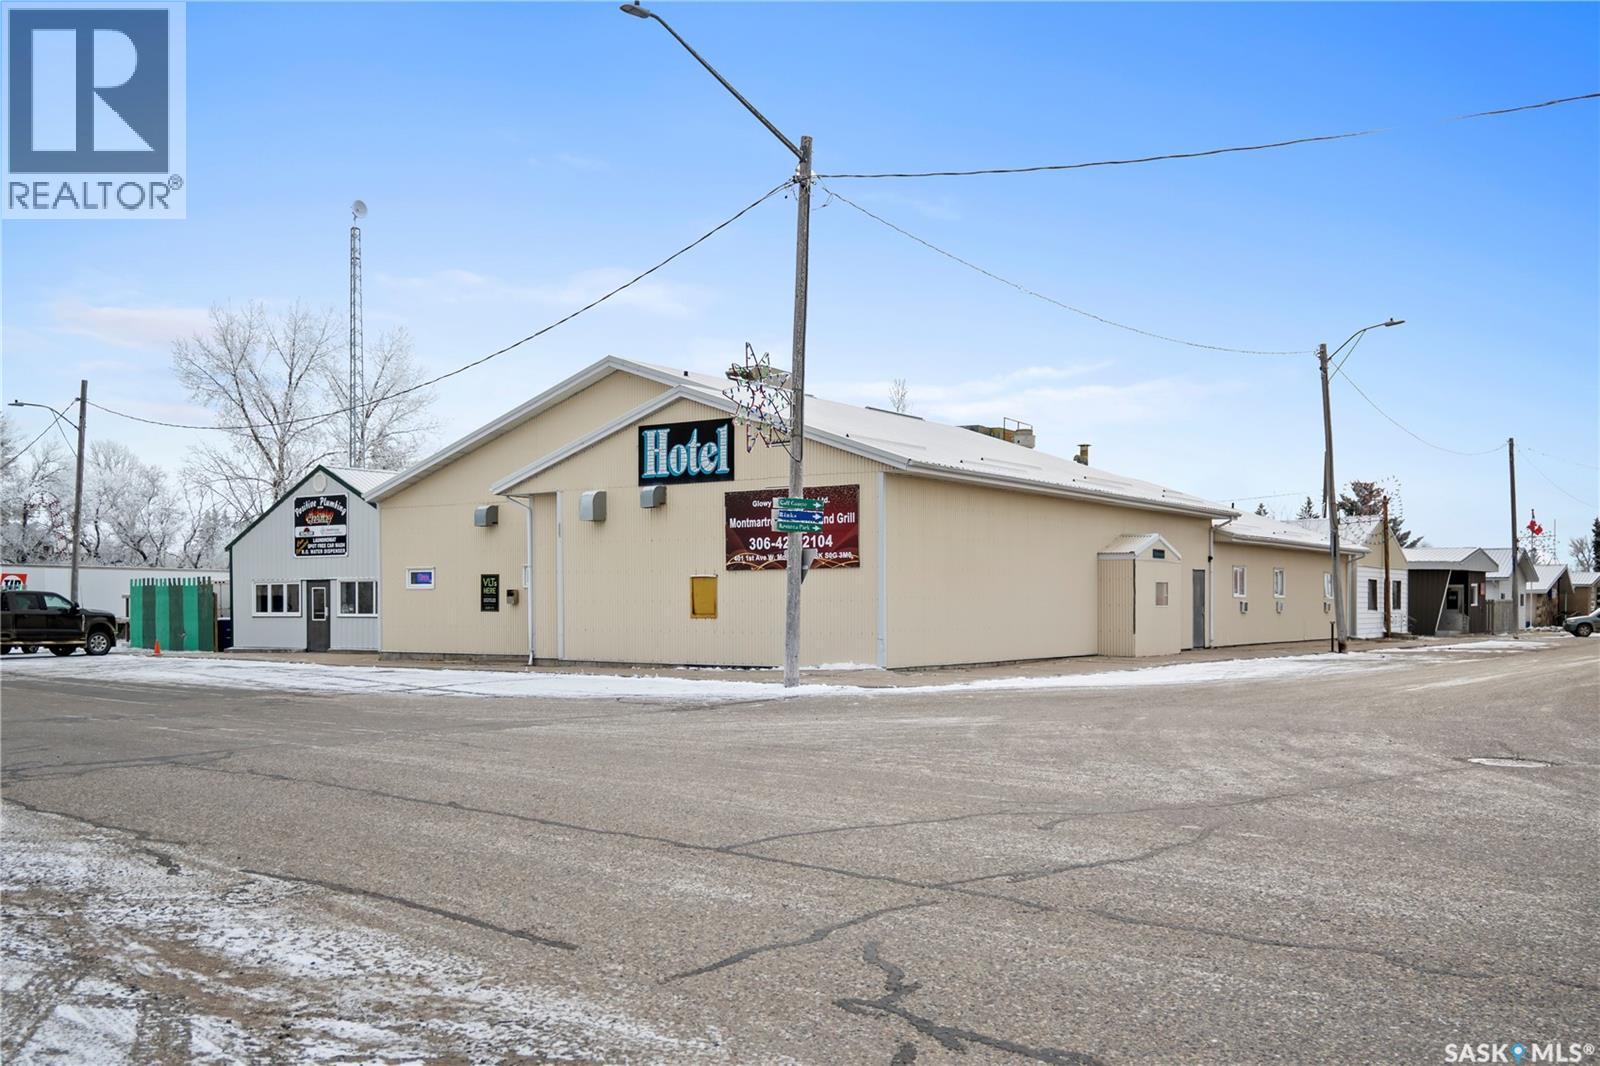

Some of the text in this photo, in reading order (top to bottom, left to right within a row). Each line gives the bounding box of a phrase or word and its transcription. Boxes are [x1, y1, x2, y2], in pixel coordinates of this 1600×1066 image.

[641, 423, 730, 478] Hotel
[320, 497, 347, 516] Plumbing
[752, 500, 772, 509] Glowy
[836, 511, 856, 524] Grill
